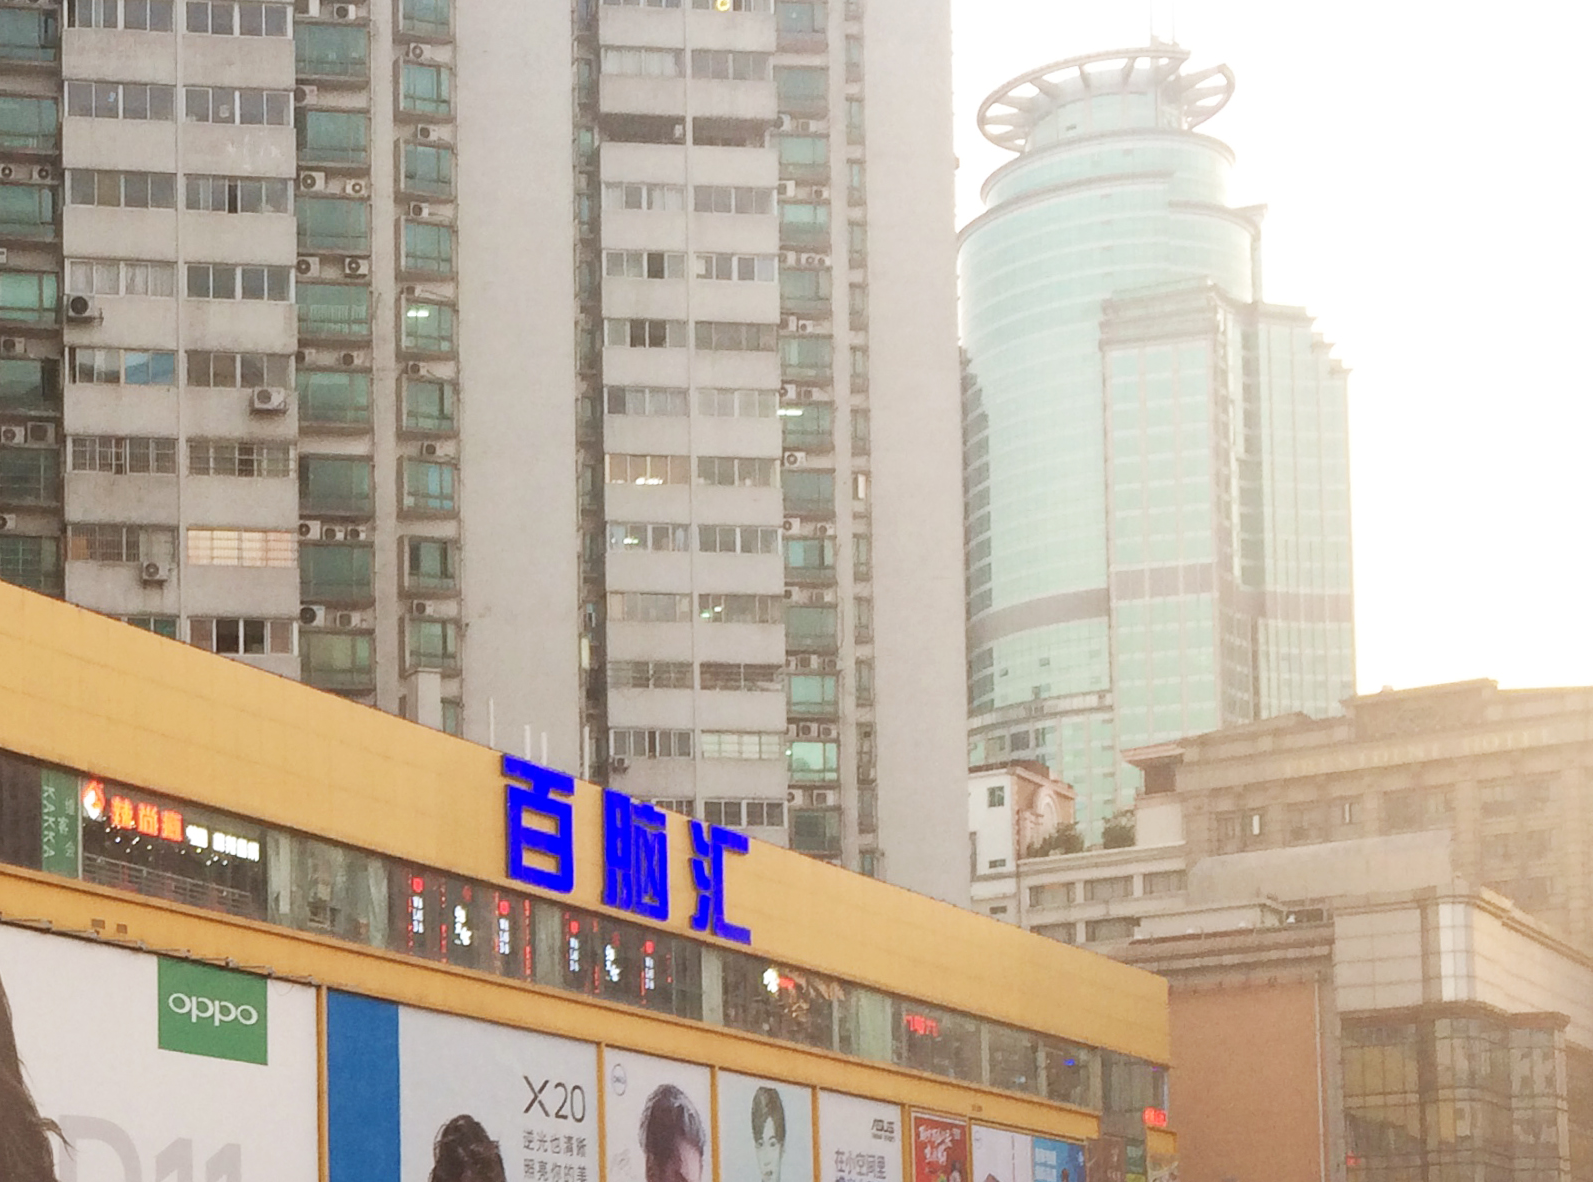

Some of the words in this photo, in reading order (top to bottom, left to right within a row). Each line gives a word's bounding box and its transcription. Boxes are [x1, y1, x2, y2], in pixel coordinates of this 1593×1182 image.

[502, 754, 751, 944] 百脑汇
[522, 1075, 586, 1123] X20
